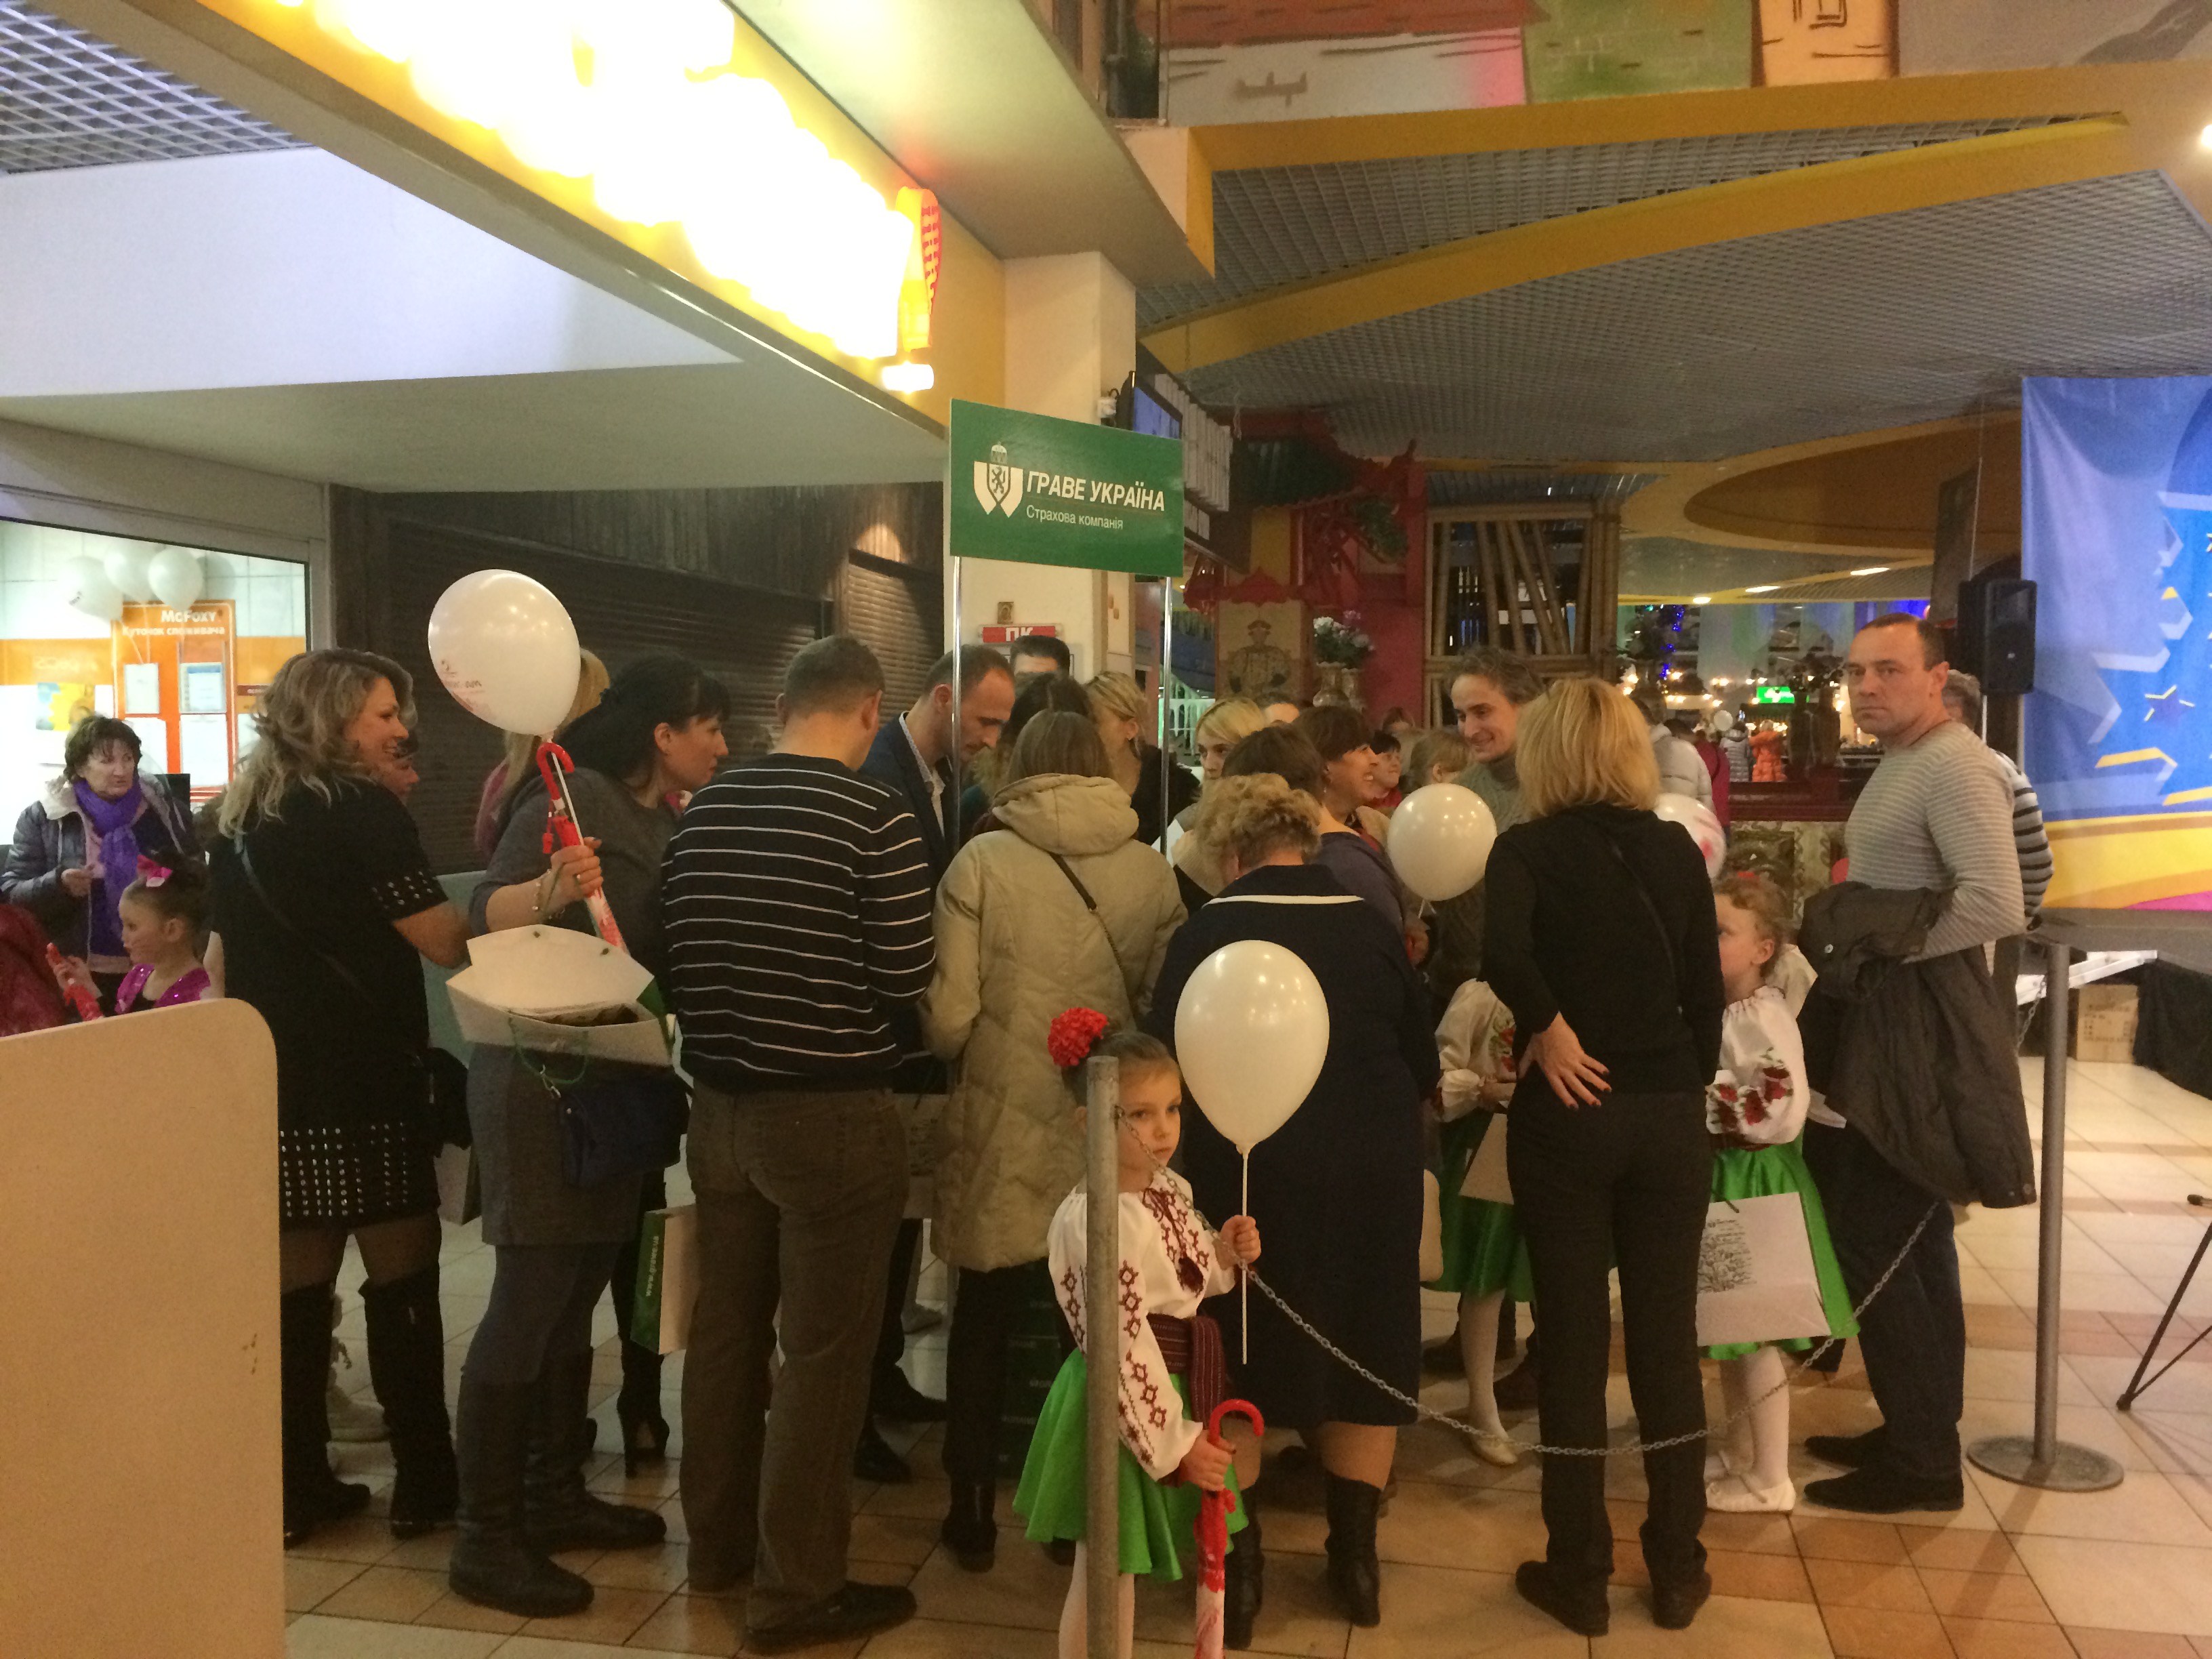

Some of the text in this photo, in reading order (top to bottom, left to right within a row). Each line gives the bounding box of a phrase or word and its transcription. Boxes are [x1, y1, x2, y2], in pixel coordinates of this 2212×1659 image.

[1027, 470, 1165, 512] ГРАВЕ УКРАЇНА
[1026, 504, 1124, 530] Страхова компанія
